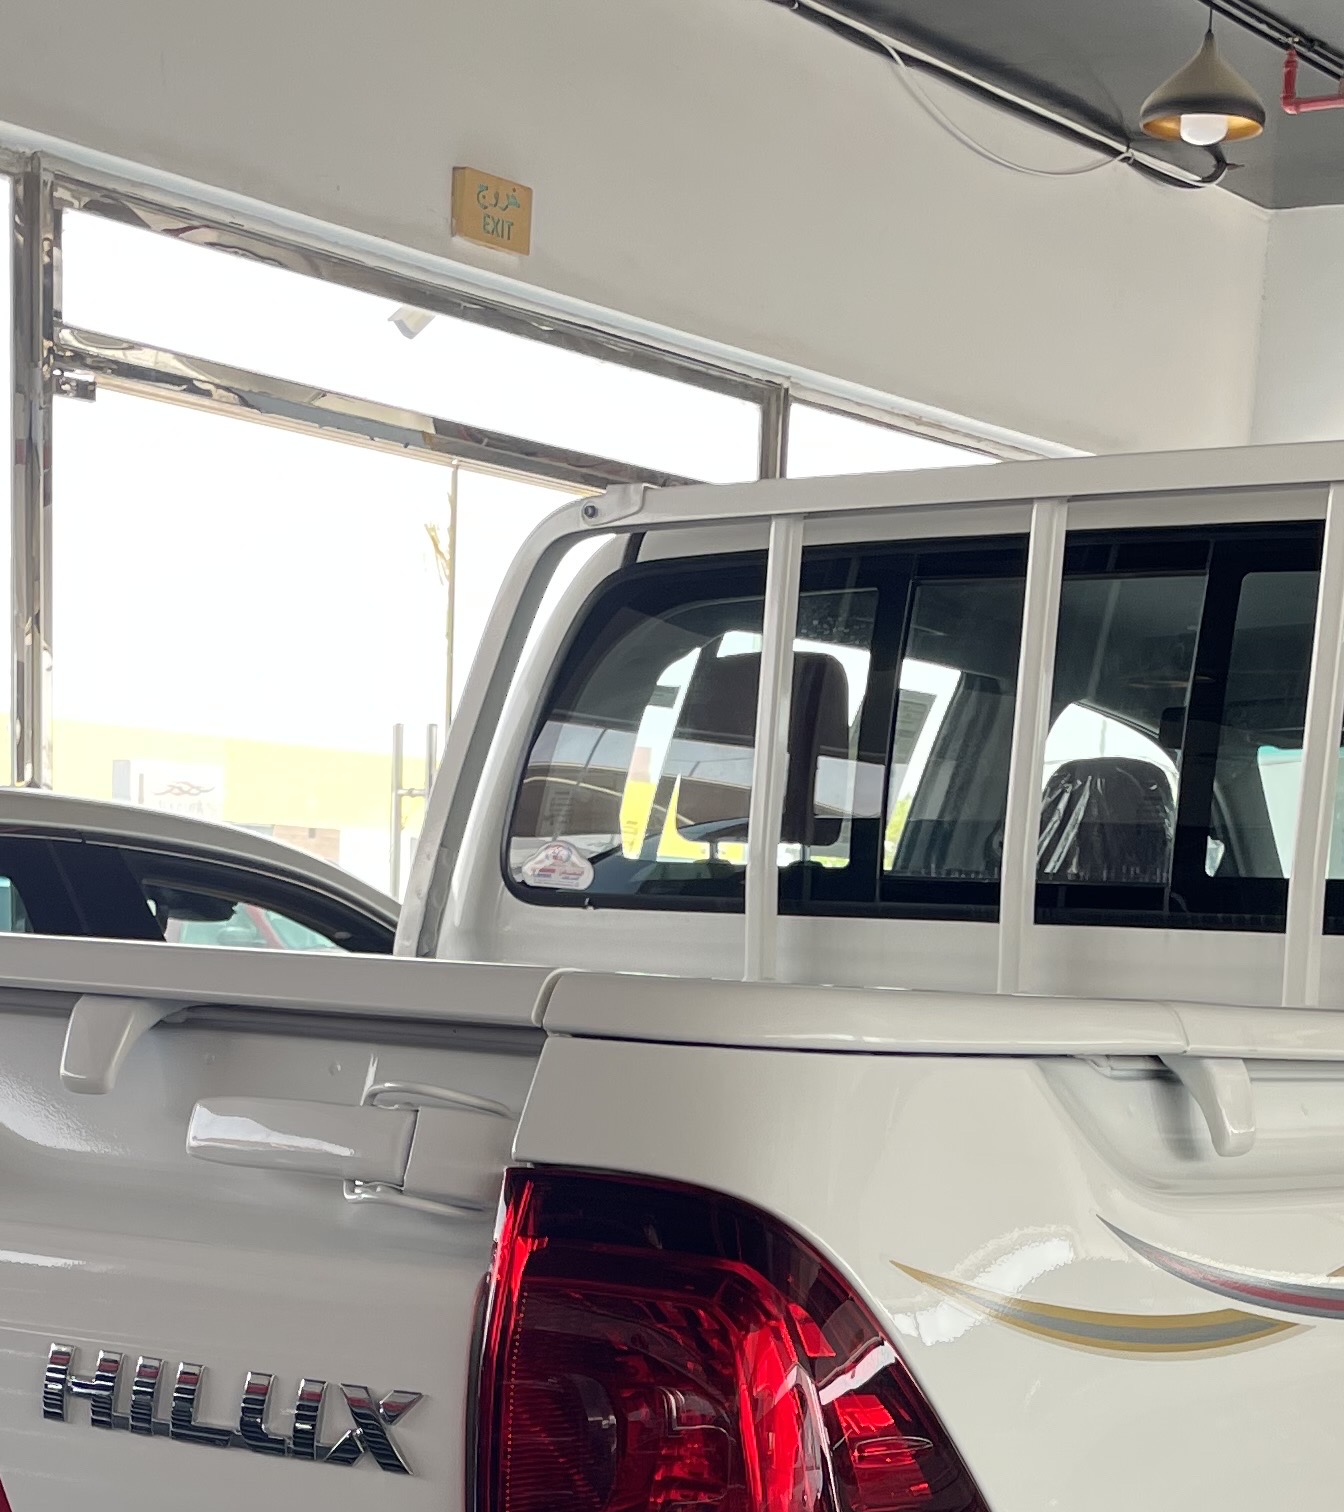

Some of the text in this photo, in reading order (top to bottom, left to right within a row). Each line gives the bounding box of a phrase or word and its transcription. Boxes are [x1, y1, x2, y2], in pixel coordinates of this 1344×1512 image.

[476, 183, 520, 210] خروج
[483, 214, 513, 240] EXIT
[42, 1341, 426, 1476] HILUX
